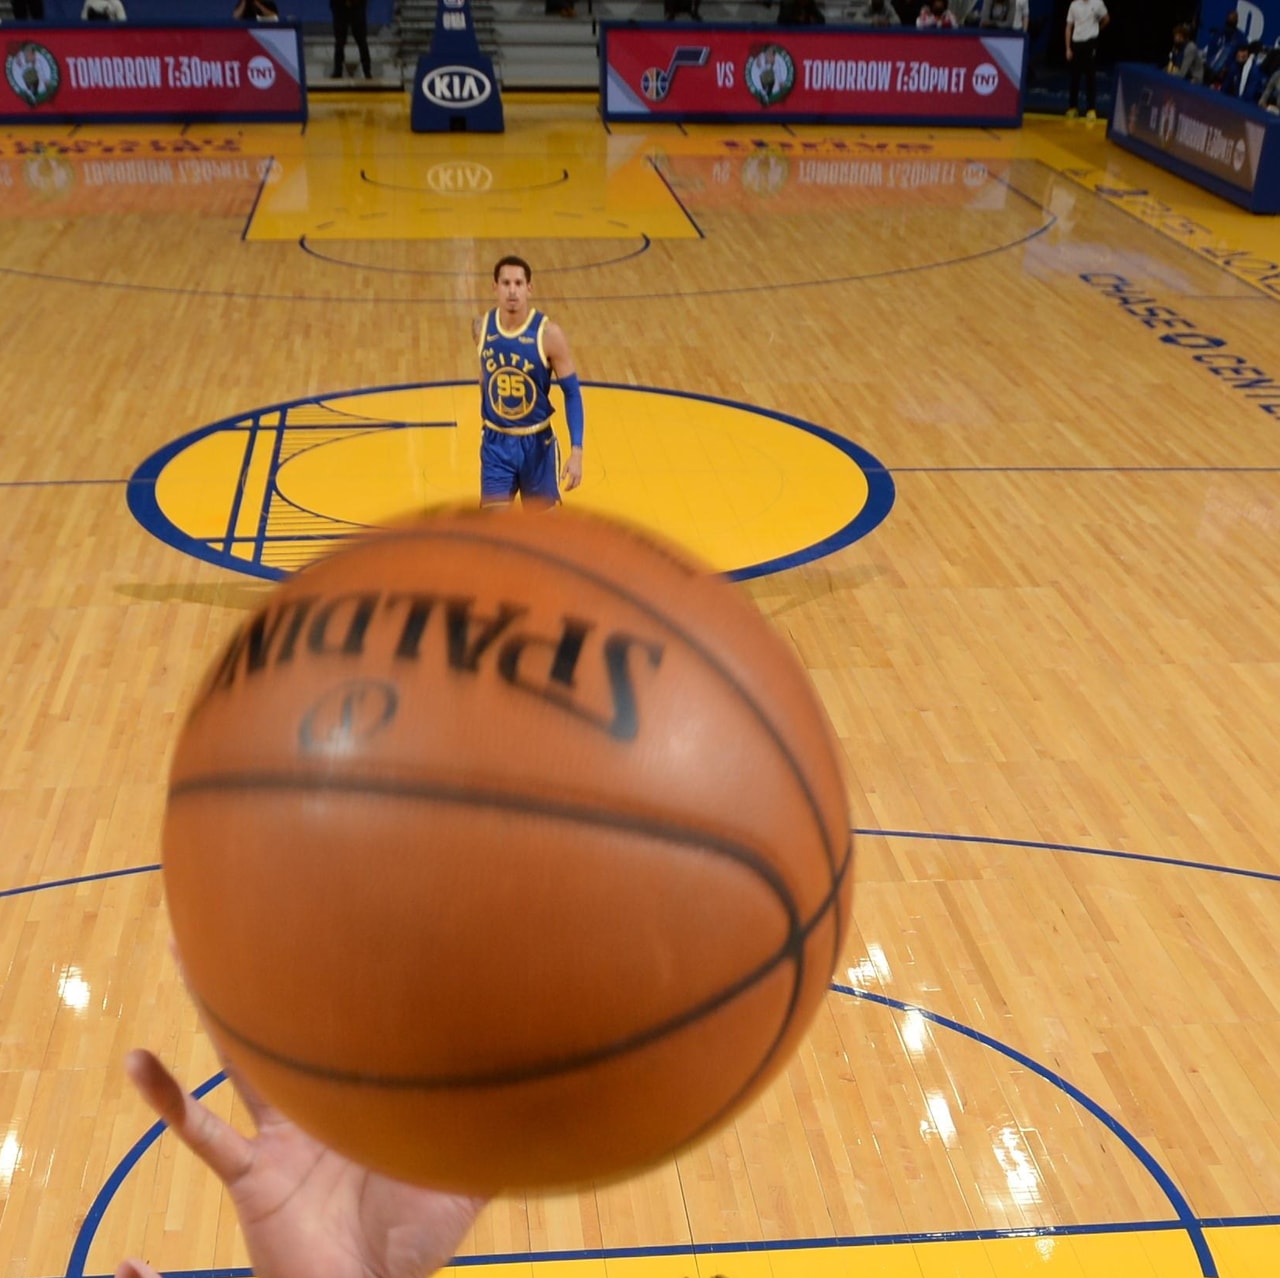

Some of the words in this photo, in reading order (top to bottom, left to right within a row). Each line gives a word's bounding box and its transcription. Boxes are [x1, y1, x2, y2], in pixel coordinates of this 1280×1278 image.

[66, 56, 162, 88] TOMORROW
[166, 56, 224, 88] 7:30PM
[226, 61, 241, 88] ET
[716, 61, 734, 88] VS
[803, 59, 892, 91] TOMORROW
[896, 60, 948, 93] 7:30PM
[950, 67, 967, 92] ET
[433, 74, 480, 99] KIA
[1079, 273, 1197, 329] CHASE
[486, 352, 534, 373] CITY
[497, 373, 526, 397] 95
